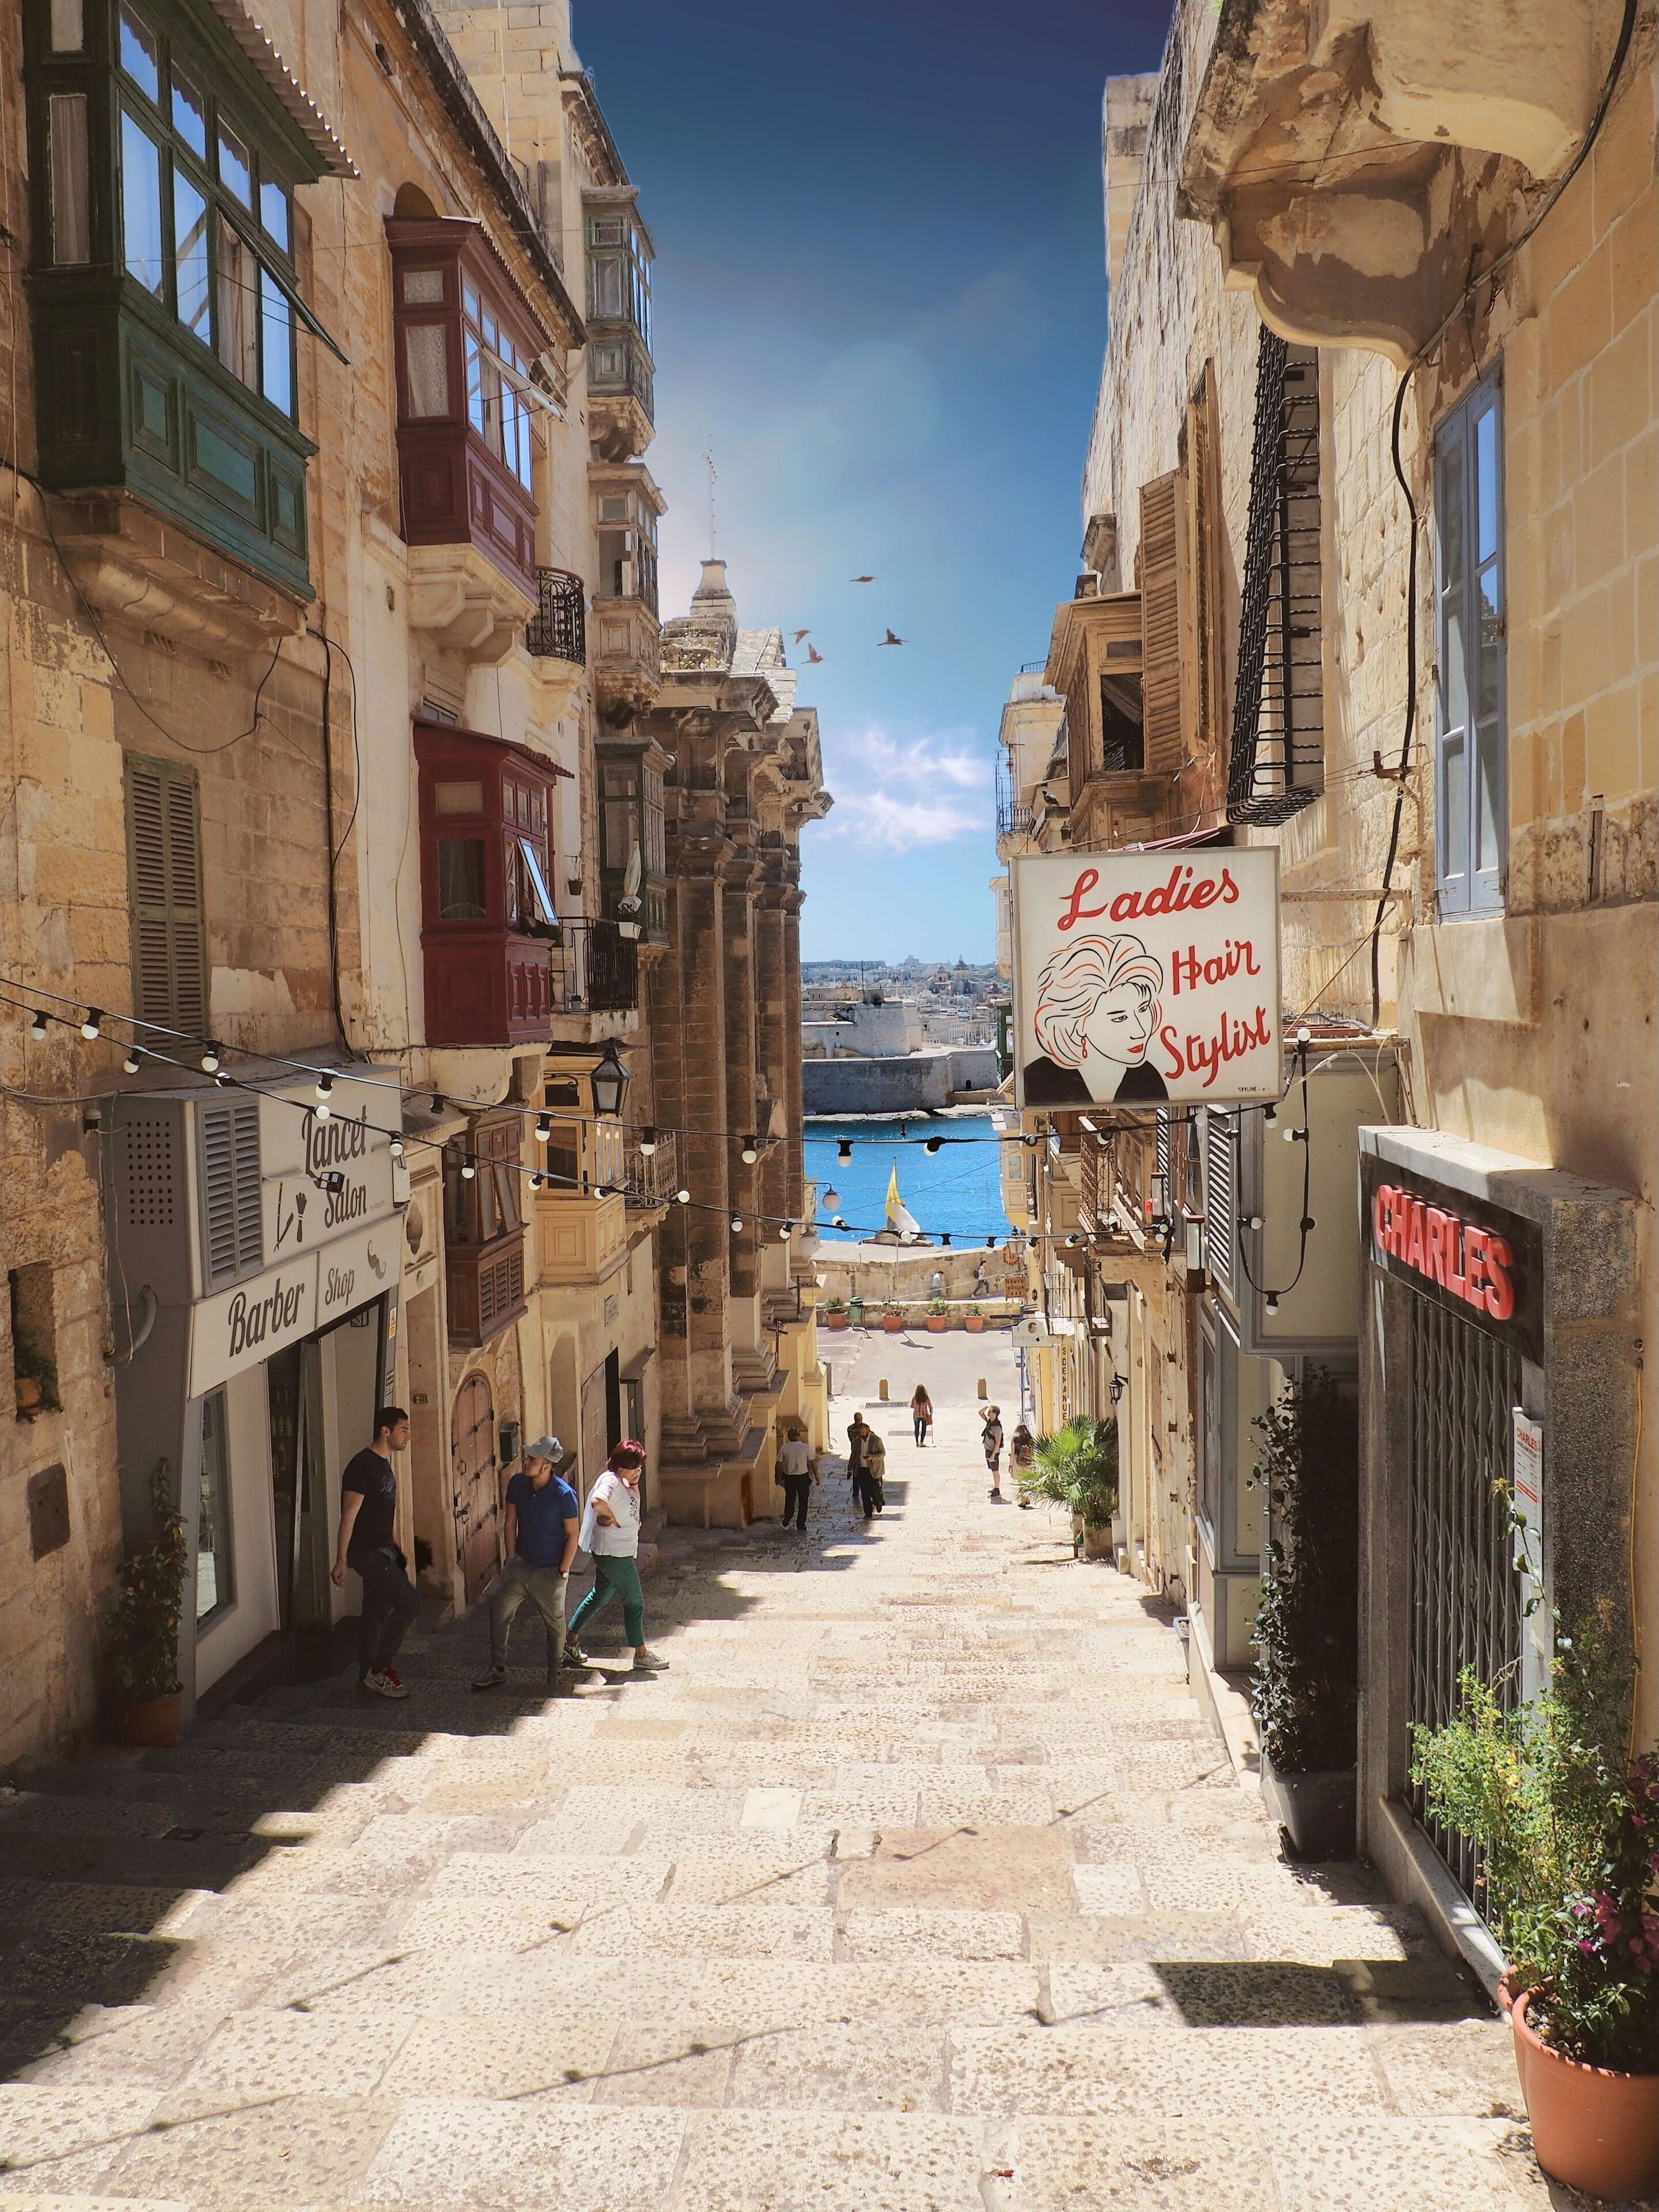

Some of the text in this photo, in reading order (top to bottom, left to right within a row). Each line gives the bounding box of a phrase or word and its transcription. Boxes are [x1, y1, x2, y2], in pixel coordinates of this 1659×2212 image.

[1058, 865, 1240, 931] Ladies
[1172, 939, 1261, 996] Hair
[1160, 1005, 1271, 1088] Stylist
[301, 1105, 367, 1178] Lancet
[324, 1178, 367, 1228] Salon
[1375, 1184, 1514, 1320] CHARLES
[228, 1267, 354, 1358] Barber Shop
[1517, 1427, 1537, 1451] CHARLES
